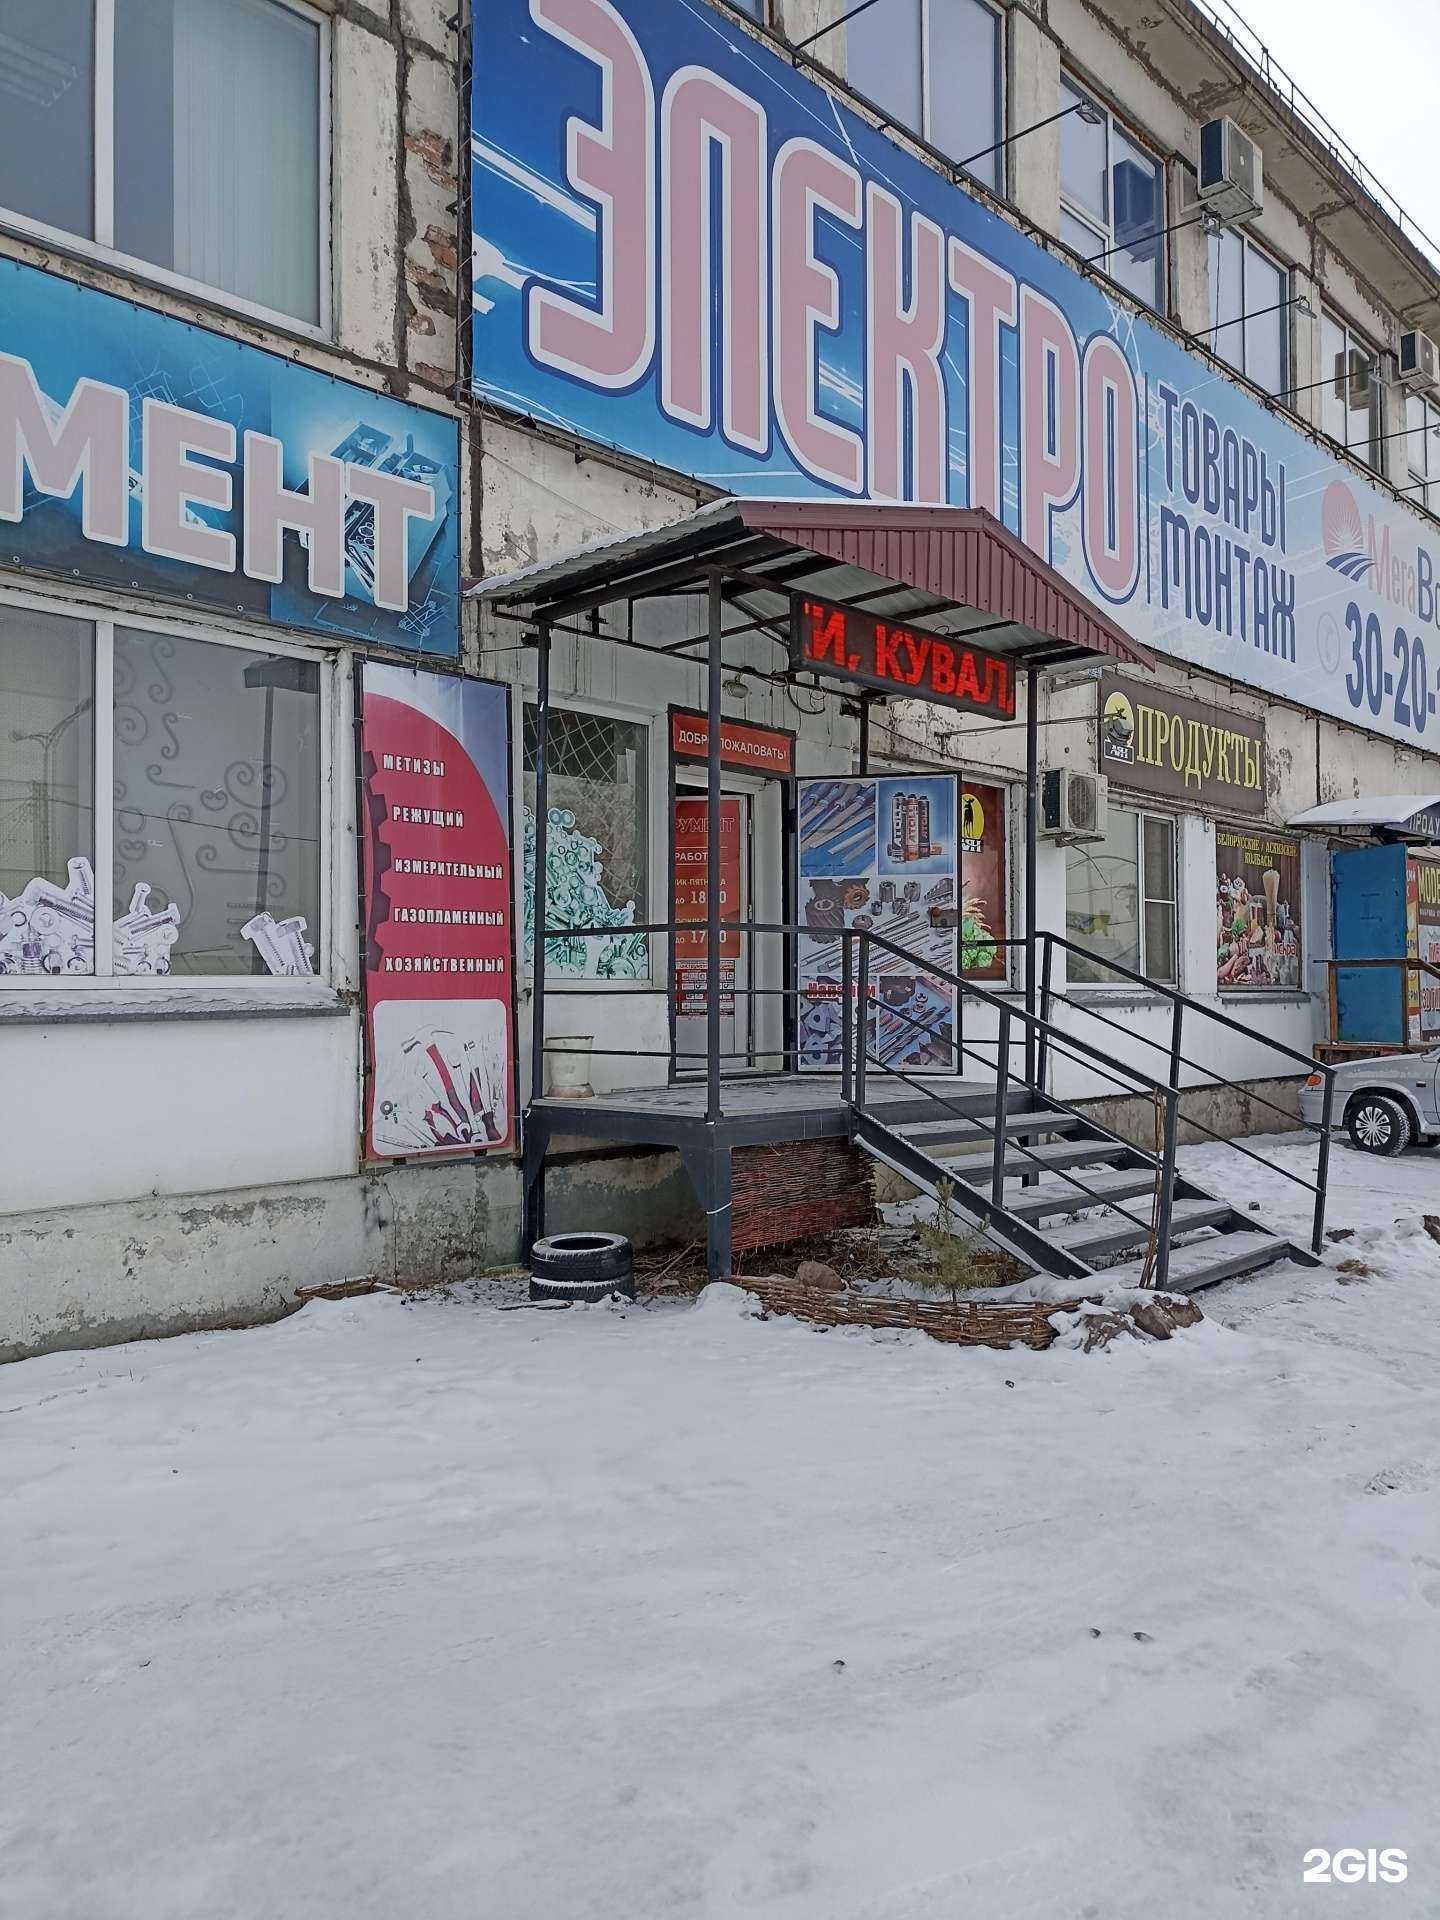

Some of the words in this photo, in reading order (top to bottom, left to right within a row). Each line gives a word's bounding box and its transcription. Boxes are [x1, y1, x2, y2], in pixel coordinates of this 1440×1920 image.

[527, 0, 1142, 604] ЭЛЕКТРО
[1158, 383, 1287, 556] ТОВАРЫ
[1160, 504, 1296, 663] МОНТАЖ
[1136, 704, 1262, 790] ПРОДУКТЫ
[383, 754, 445, 777] МЕТИЗЫ
[392, 805, 464, 829] РЕЖУЩИЙ
[1216, 832, 1260, 851] БЕЛОРУССКИЕ
[394, 858, 503, 880] ИЗМЕРИТЕЛЬНЫЙ
[1244, 852, 1273, 868] КОЛБАСЫ
[393, 907, 504, 926] ГАЗОПЛАМЕННЫЙ
[384, 955, 504, 973] ХОЗЯЙСТВЕННЫЙ
